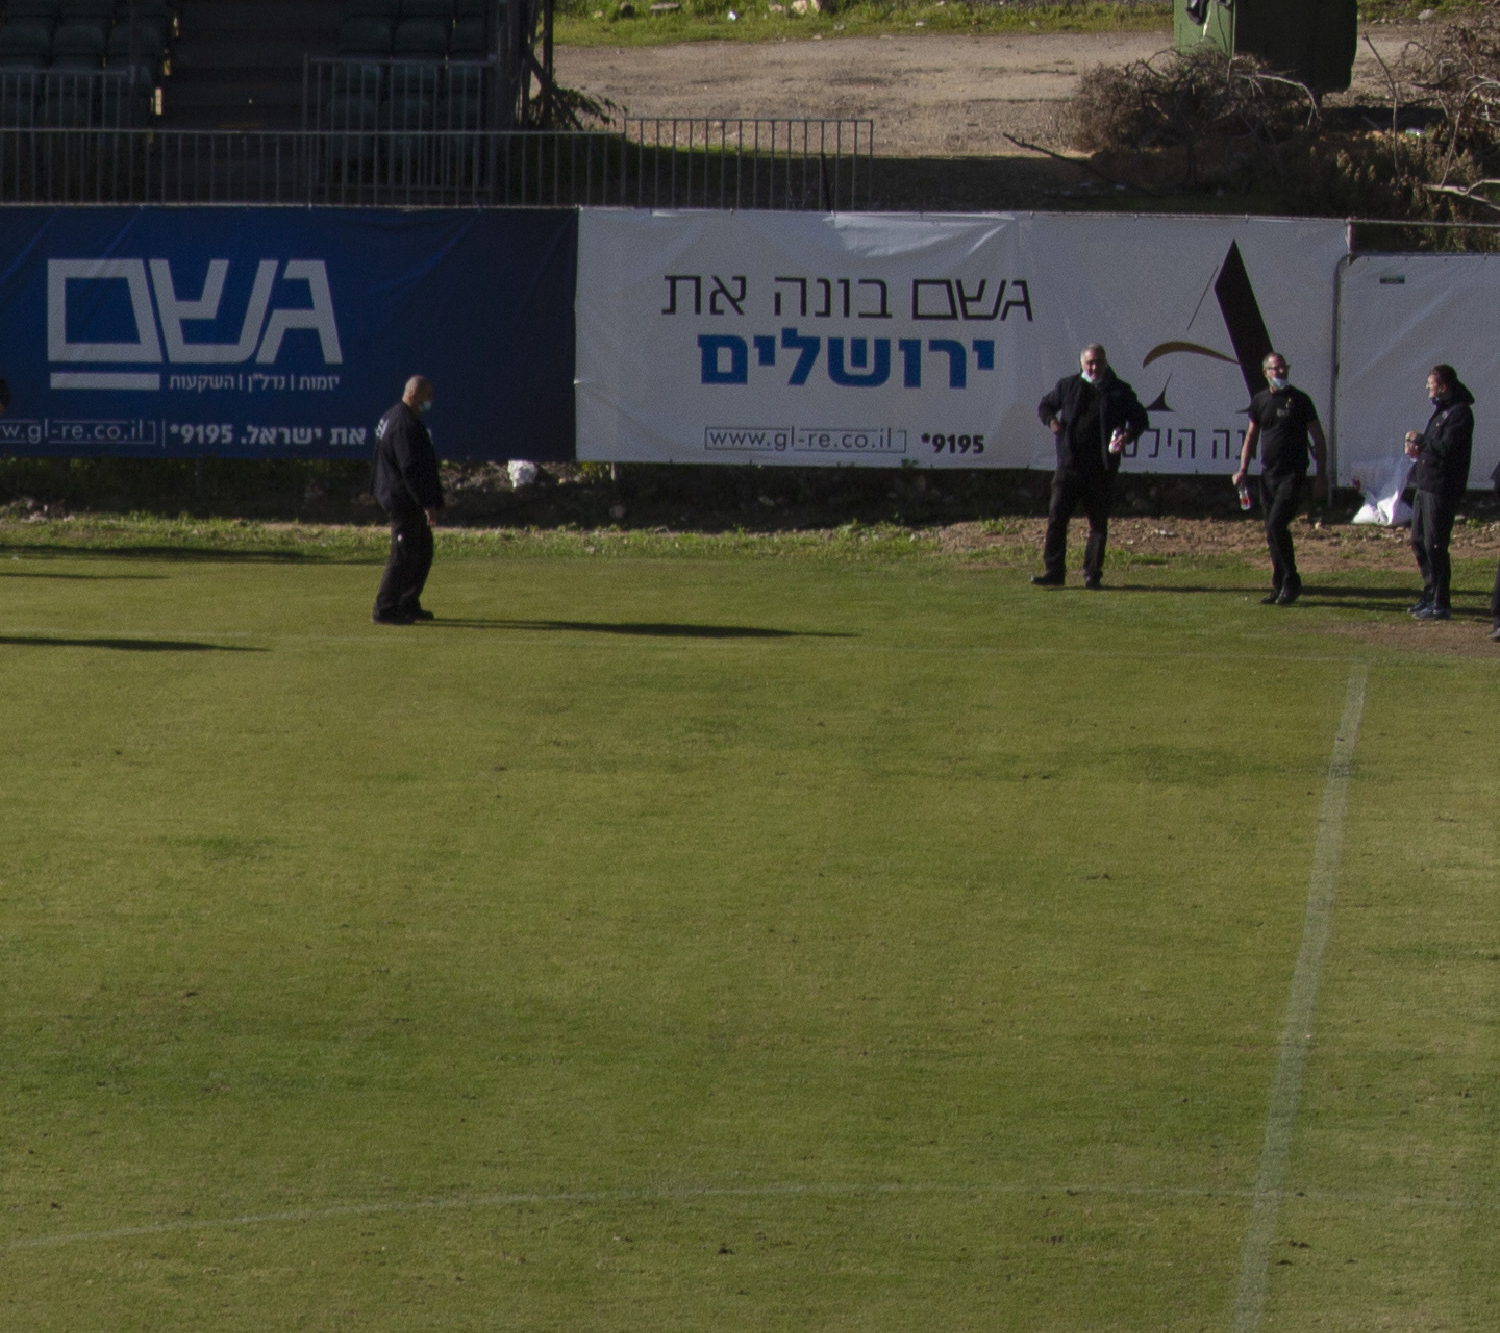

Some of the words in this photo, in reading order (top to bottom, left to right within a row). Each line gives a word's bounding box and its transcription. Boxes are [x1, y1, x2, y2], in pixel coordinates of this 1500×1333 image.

[47, 258, 344, 365] גשם
[660, 274, 748, 316] את
[773, 275, 893, 320] בונה
[911, 278, 1034, 322] גשם
[697, 327, 996, 390] ירושלים
[168, 374, 235, 392] השקעות
[299, 375, 341, 391] יזמות
[240, 423, 321, 446] ישראל.
[329, 427, 367, 445] את
[709, 426, 893, 452] www.gl-re.co.il
